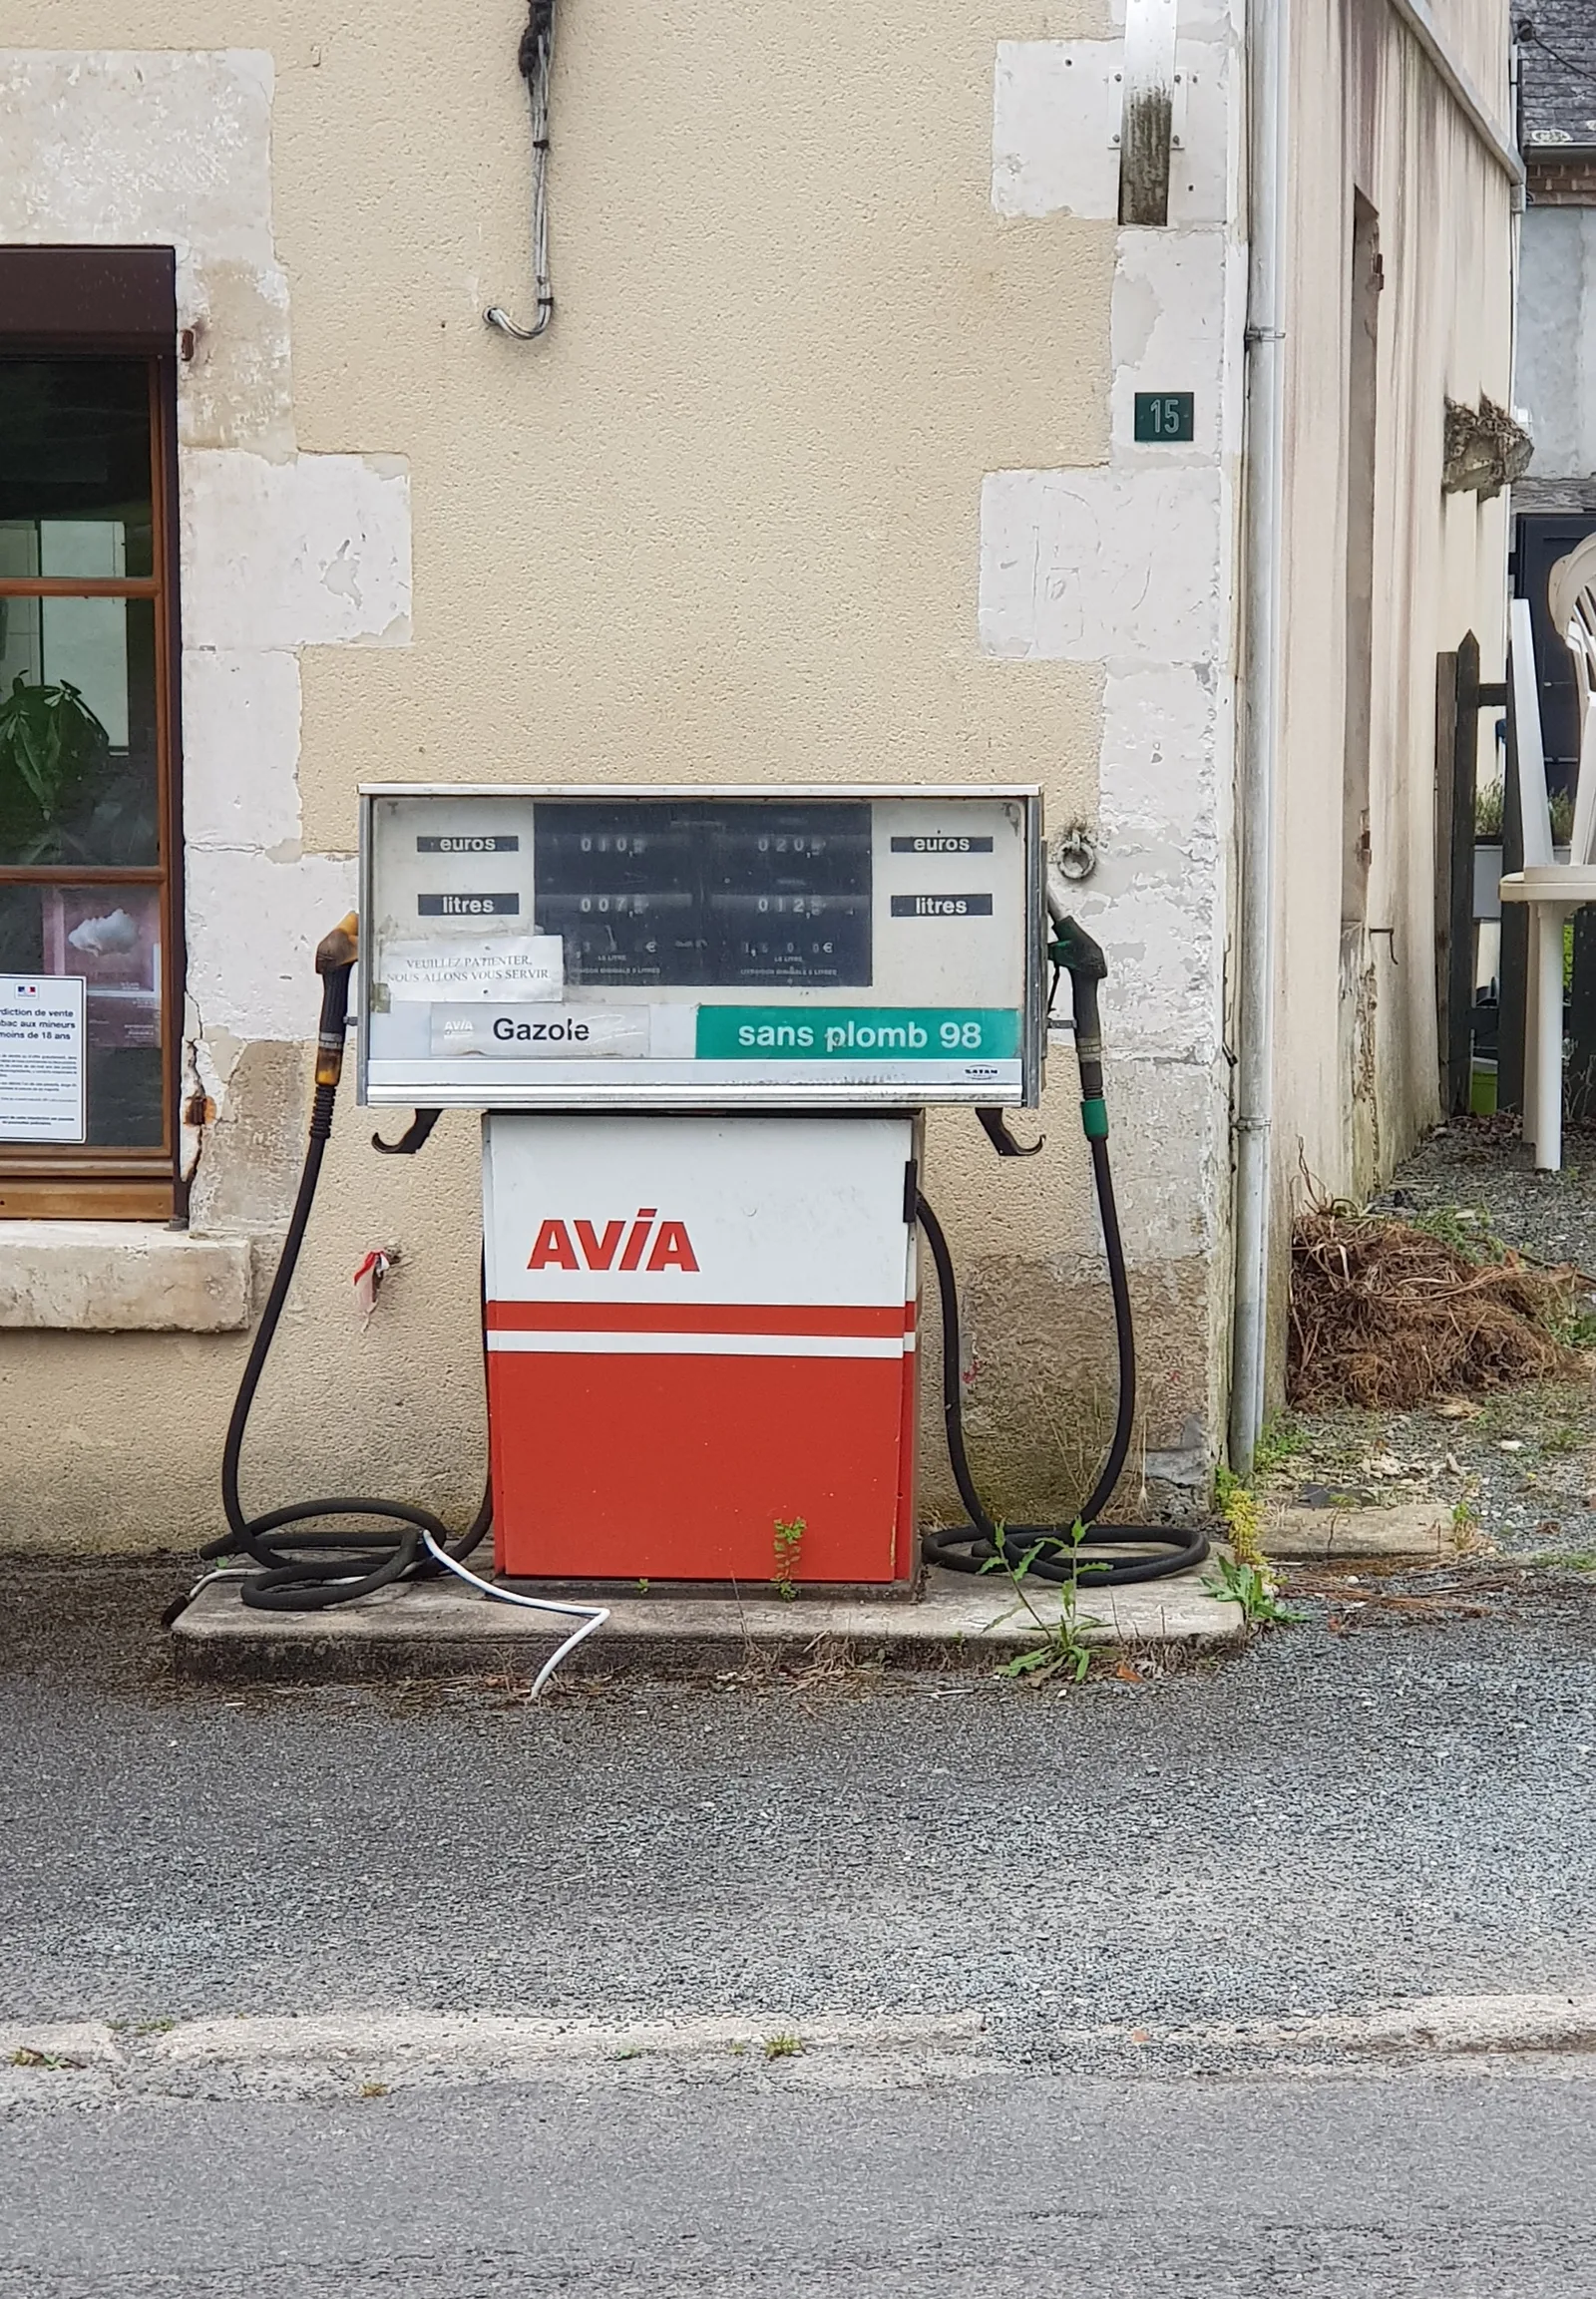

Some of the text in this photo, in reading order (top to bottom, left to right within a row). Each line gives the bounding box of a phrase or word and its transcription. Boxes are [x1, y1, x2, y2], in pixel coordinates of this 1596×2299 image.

[1150, 399, 1180, 434] 15
[439, 838, 497, 852] euros
[914, 837, 971, 851] euros
[442, 896, 496, 914] litres
[915, 897, 968, 915] litres
[406, 955, 534, 969] VEUILLEZ PATIENTER,
[386, 968, 550, 982] NOUS ALLONS VOUS SERVIR
[39, 1020, 77, 1029] mineurs
[493, 1017, 590, 1041] Gazole
[738, 1020, 983, 1052] sans plomb 98
[526, 1207, 701, 1273] AVIA
